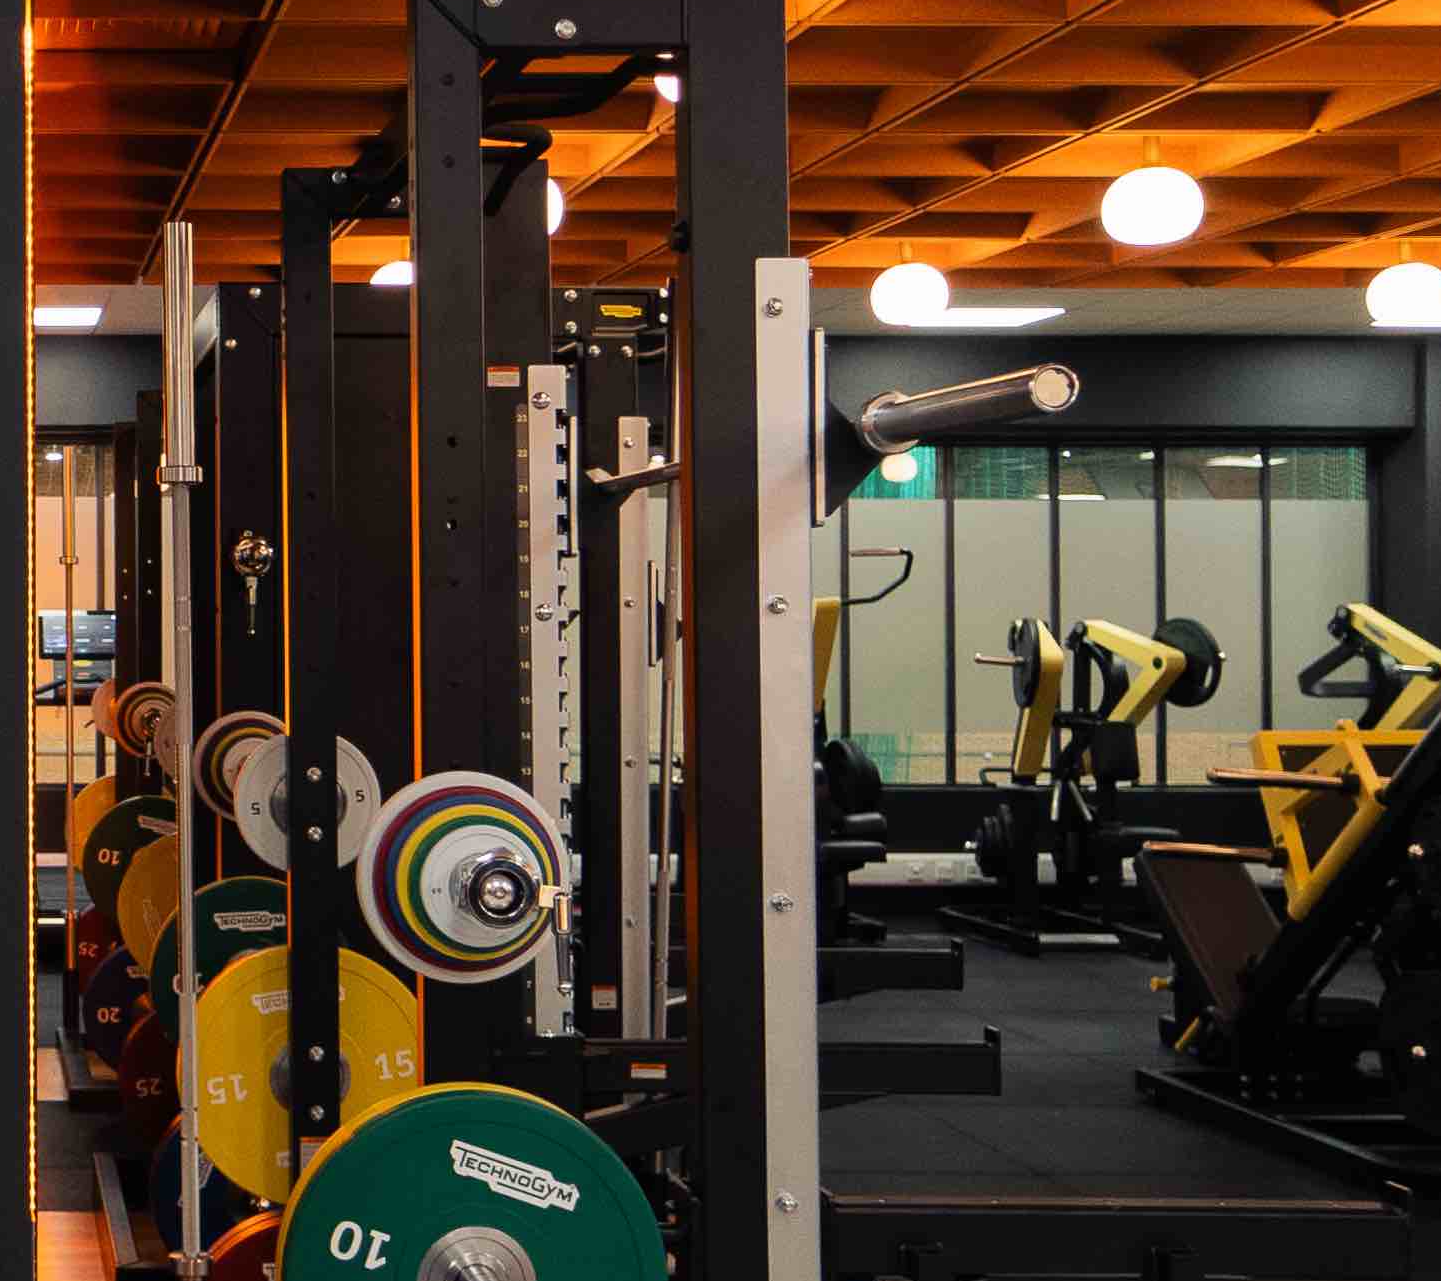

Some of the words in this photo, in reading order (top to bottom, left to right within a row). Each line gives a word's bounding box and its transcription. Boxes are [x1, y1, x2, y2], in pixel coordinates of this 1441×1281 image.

[355, 790, 365, 802] 5
[250, 802, 261, 816] 5
[98, 848, 120, 866] 10
[97, 1007, 121, 1024] 20
[375, 1049, 416, 1081] 15
[136, 1077, 162, 1097] 25
[207, 1073, 248, 1104] 15
[454, 1145, 574, 1203] TECHNOGYM
[329, 1220, 391, 1270] 10
